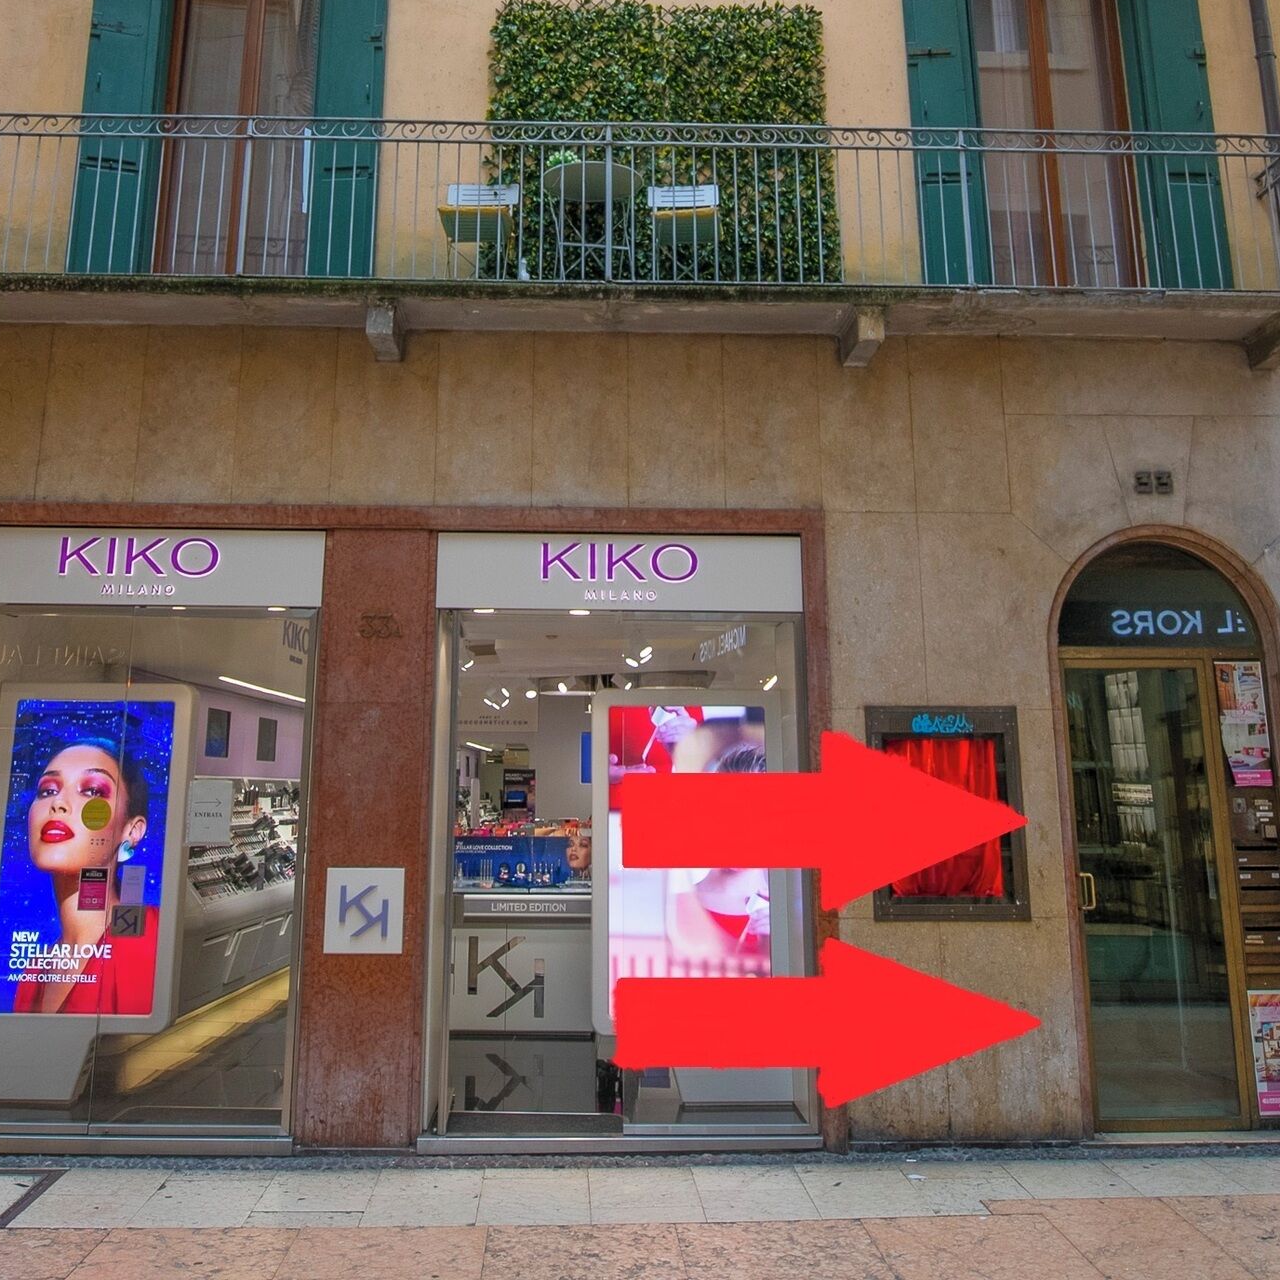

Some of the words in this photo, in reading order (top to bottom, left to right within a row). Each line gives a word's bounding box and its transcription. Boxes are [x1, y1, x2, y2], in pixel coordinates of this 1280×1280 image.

[58, 536, 220, 578] KIKO
[541, 542, 698, 583] KIKO
[100, 584, 176, 597] MILANO
[584, 590, 658, 601] MILANO
[491, 903, 527, 912] LIMITED
[529, 903, 567, 912] EDITION
[12, 931, 39, 942] NEW
[10, 944, 70, 958] STELLAR
[73, 944, 112, 959] LOVE
[9, 958, 80, 970] COLLECTION
[7, 973, 37, 982] AMORE
[38, 974, 61, 983] OLTRE
[62, 974, 71, 983] LE
[71, 974, 97, 983] STELLE
